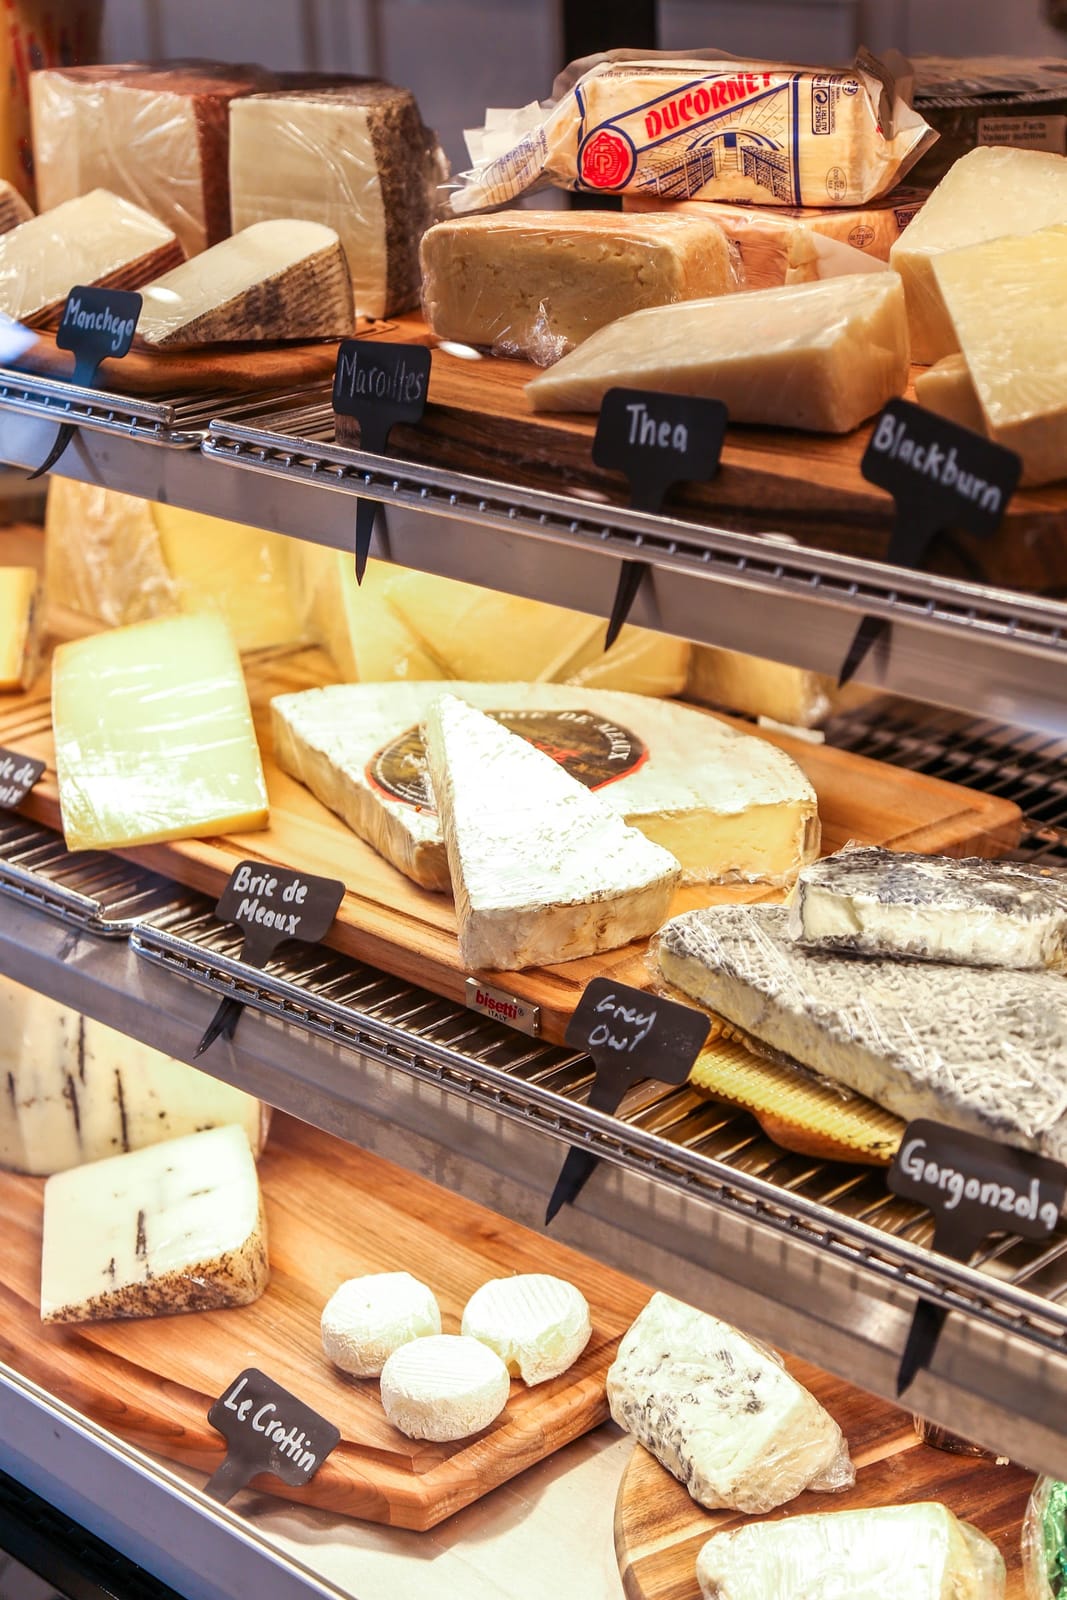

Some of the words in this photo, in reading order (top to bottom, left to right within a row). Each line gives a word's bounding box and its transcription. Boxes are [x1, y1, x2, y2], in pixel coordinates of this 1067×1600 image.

[645, 72, 772, 138] DUCORNET
[63, 297, 135, 352] Manchego
[625, 403, 688, 453] Thea
[873, 413, 1002, 513] Blackburn
[556, 711, 594, 725] DE
[233, 866, 278, 897] Brie
[282, 879, 308, 904] de
[235, 898, 302, 935] Meaux
[488, 1009, 507, 1022] ITALY
[588, 1025, 645, 1052] Owl
[900, 1138, 1059, 1231] Gorgonzola
[223, 1377, 253, 1421] Le
[252, 1402, 317, 1473] Crottin
